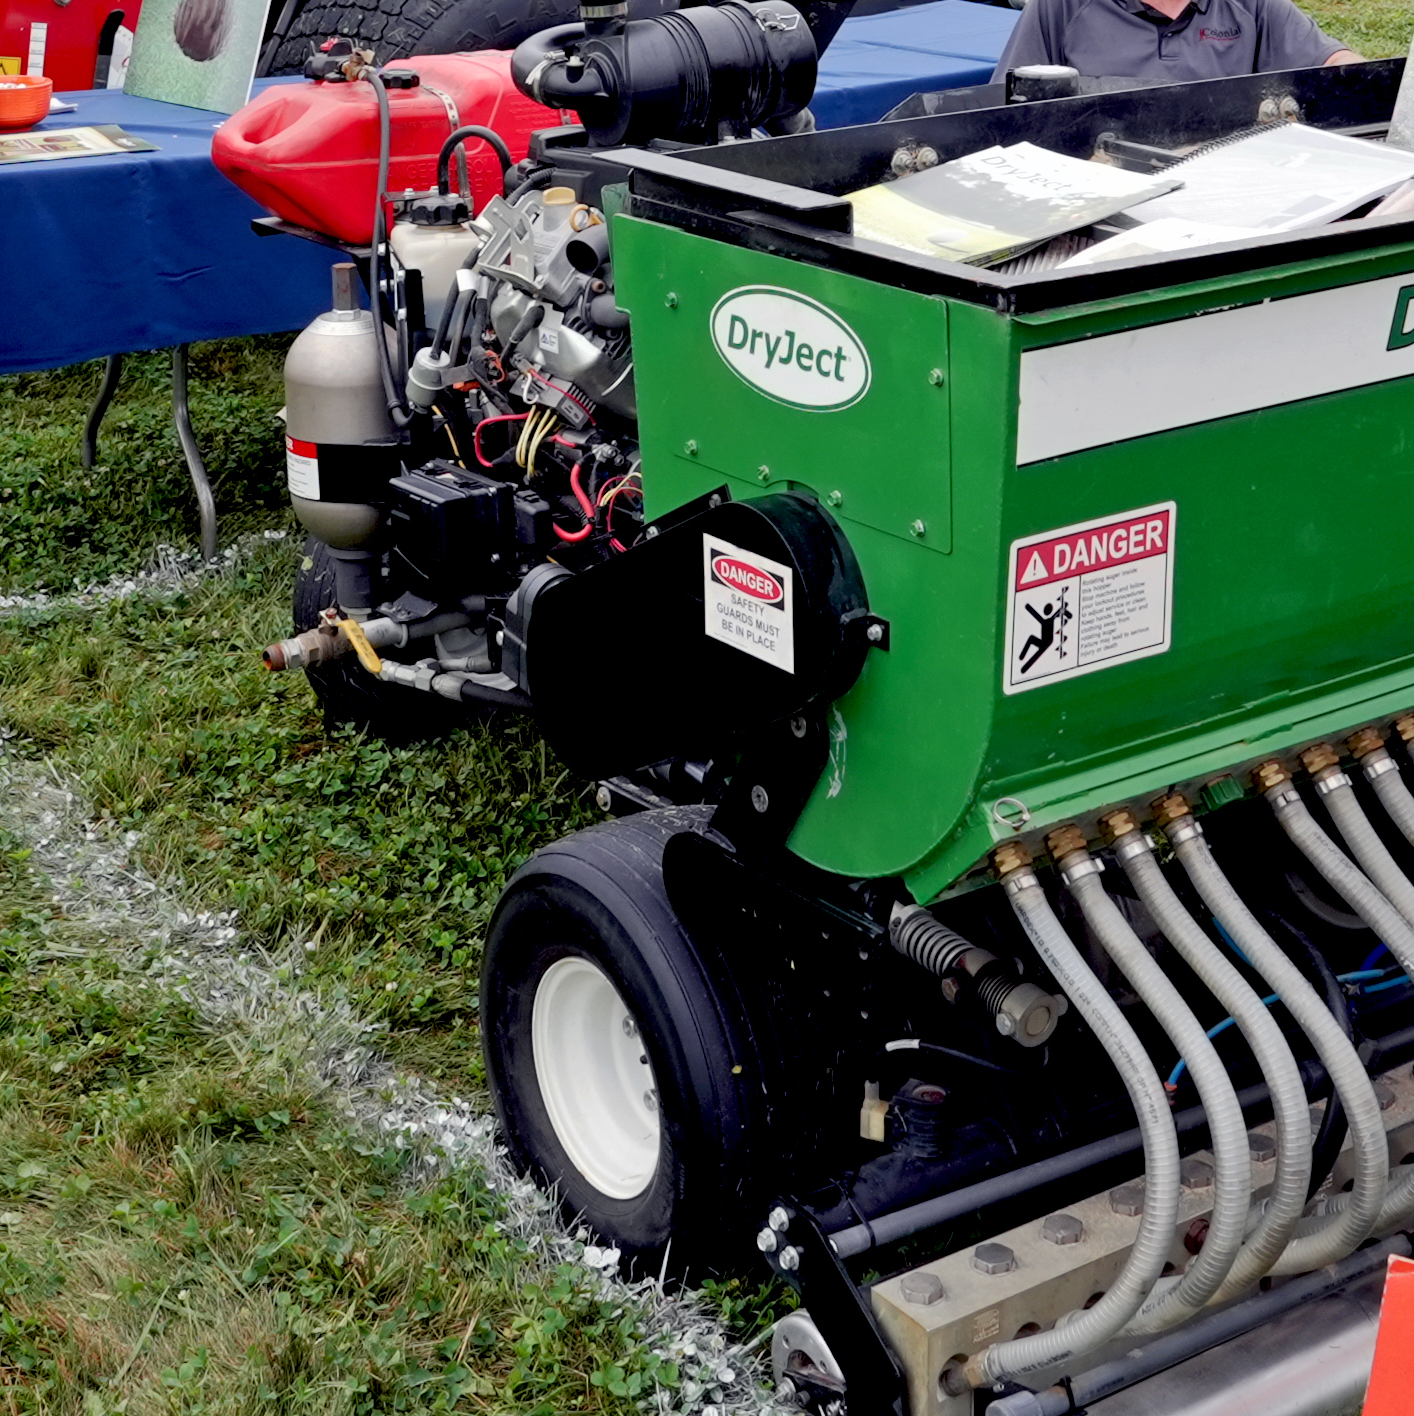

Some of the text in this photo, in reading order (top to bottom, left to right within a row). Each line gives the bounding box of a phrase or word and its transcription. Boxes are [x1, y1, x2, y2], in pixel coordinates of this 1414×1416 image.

[1202, 24, 1242, 38] Colonial
[980, 155, 1072, 191] DryJect
[727, 313, 847, 382] DryJect
[1053, 519, 1163, 575] DANGER
[720, 561, 774, 598] DANGER
[717, 603, 780, 638] GUARDS MUST
[731, 593, 765, 616] SAFETY
[722, 619, 733, 632] BE
[736, 625, 744, 637] IN
[747, 630, 776, 651] PLACE
